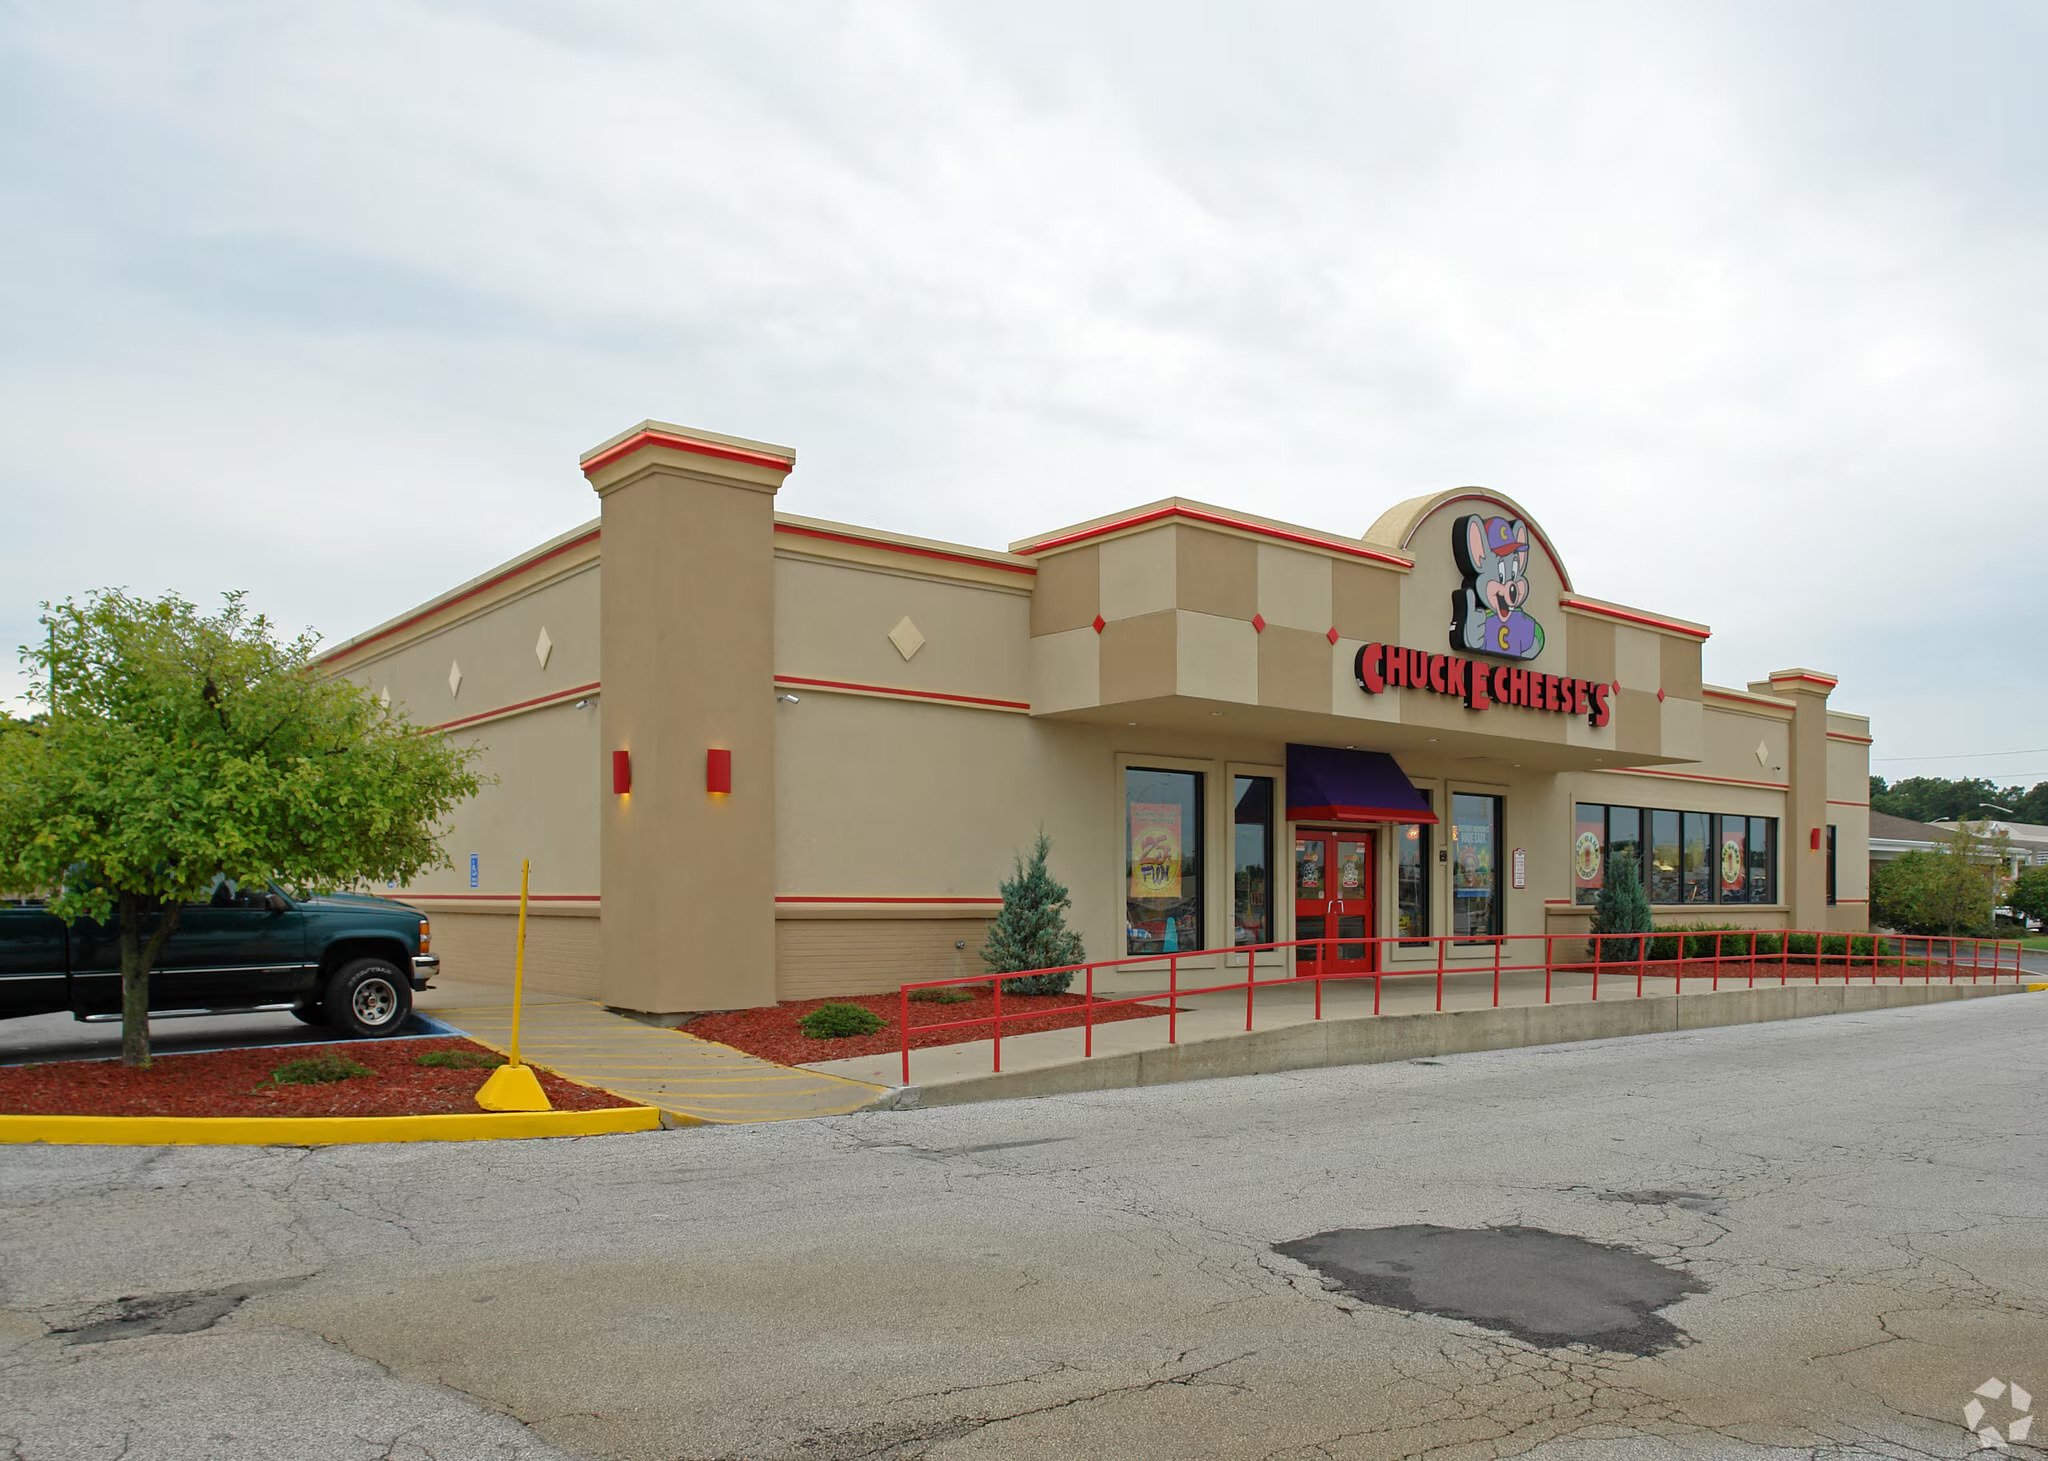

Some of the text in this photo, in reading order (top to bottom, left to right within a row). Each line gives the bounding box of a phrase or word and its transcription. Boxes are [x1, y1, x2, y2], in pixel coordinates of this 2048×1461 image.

[1500, 526, 1508, 540] C
[1498, 625, 1510, 650] C
[1357, 642, 1610, 727] CHUCK E CHEESE'S
[1141, 864, 1170, 885] FUN
